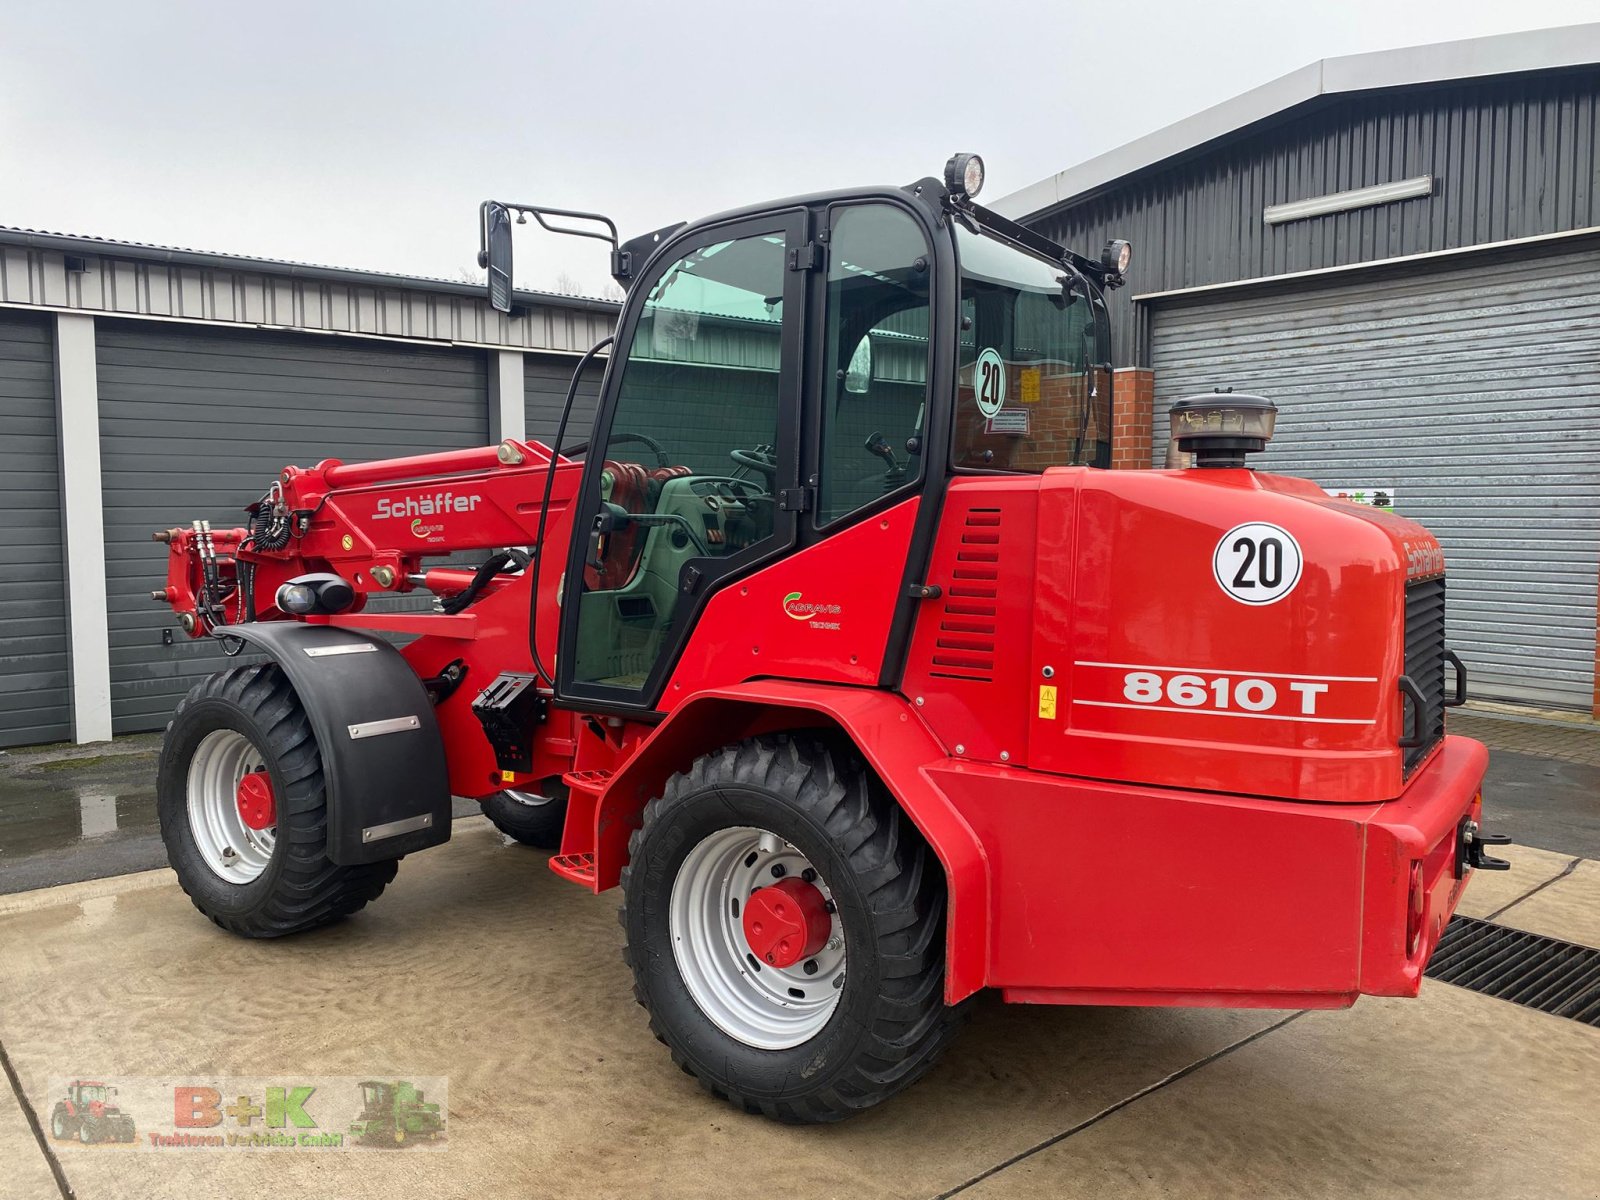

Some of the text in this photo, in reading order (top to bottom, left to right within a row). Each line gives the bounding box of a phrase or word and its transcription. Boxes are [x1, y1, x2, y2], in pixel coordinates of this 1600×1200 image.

[980, 360, 1001, 406] 20
[372, 493, 481, 519] Schäffer
[1232, 537, 1283, 589] 20
[1123, 671, 1329, 715] 8610 T
